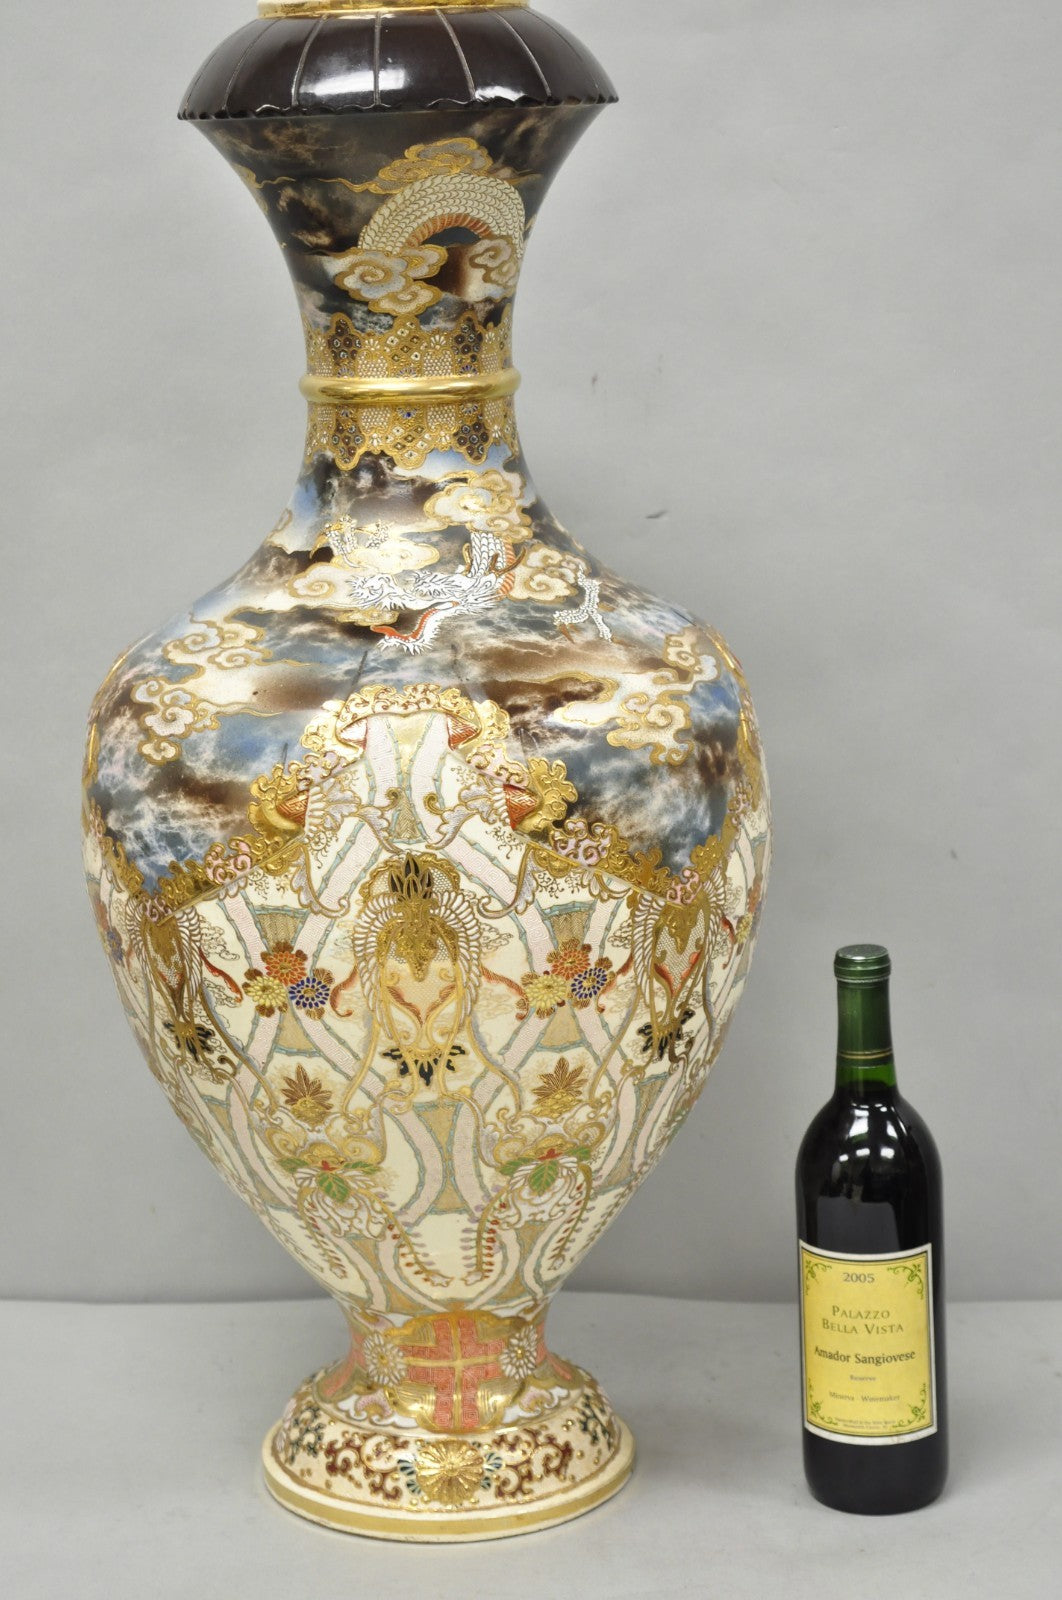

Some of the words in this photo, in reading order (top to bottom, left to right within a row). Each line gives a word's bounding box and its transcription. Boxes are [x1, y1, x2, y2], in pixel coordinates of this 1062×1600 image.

[843, 1272, 875, 1283] 2005
[833, 1305, 890, 1319] PALAZZO
[822, 1319, 858, 1334] BELLA
[865, 1324, 904, 1335] VISTA
[814, 1346, 851, 1363] Amador
[854, 1351, 916, 1366] Sangiovese
